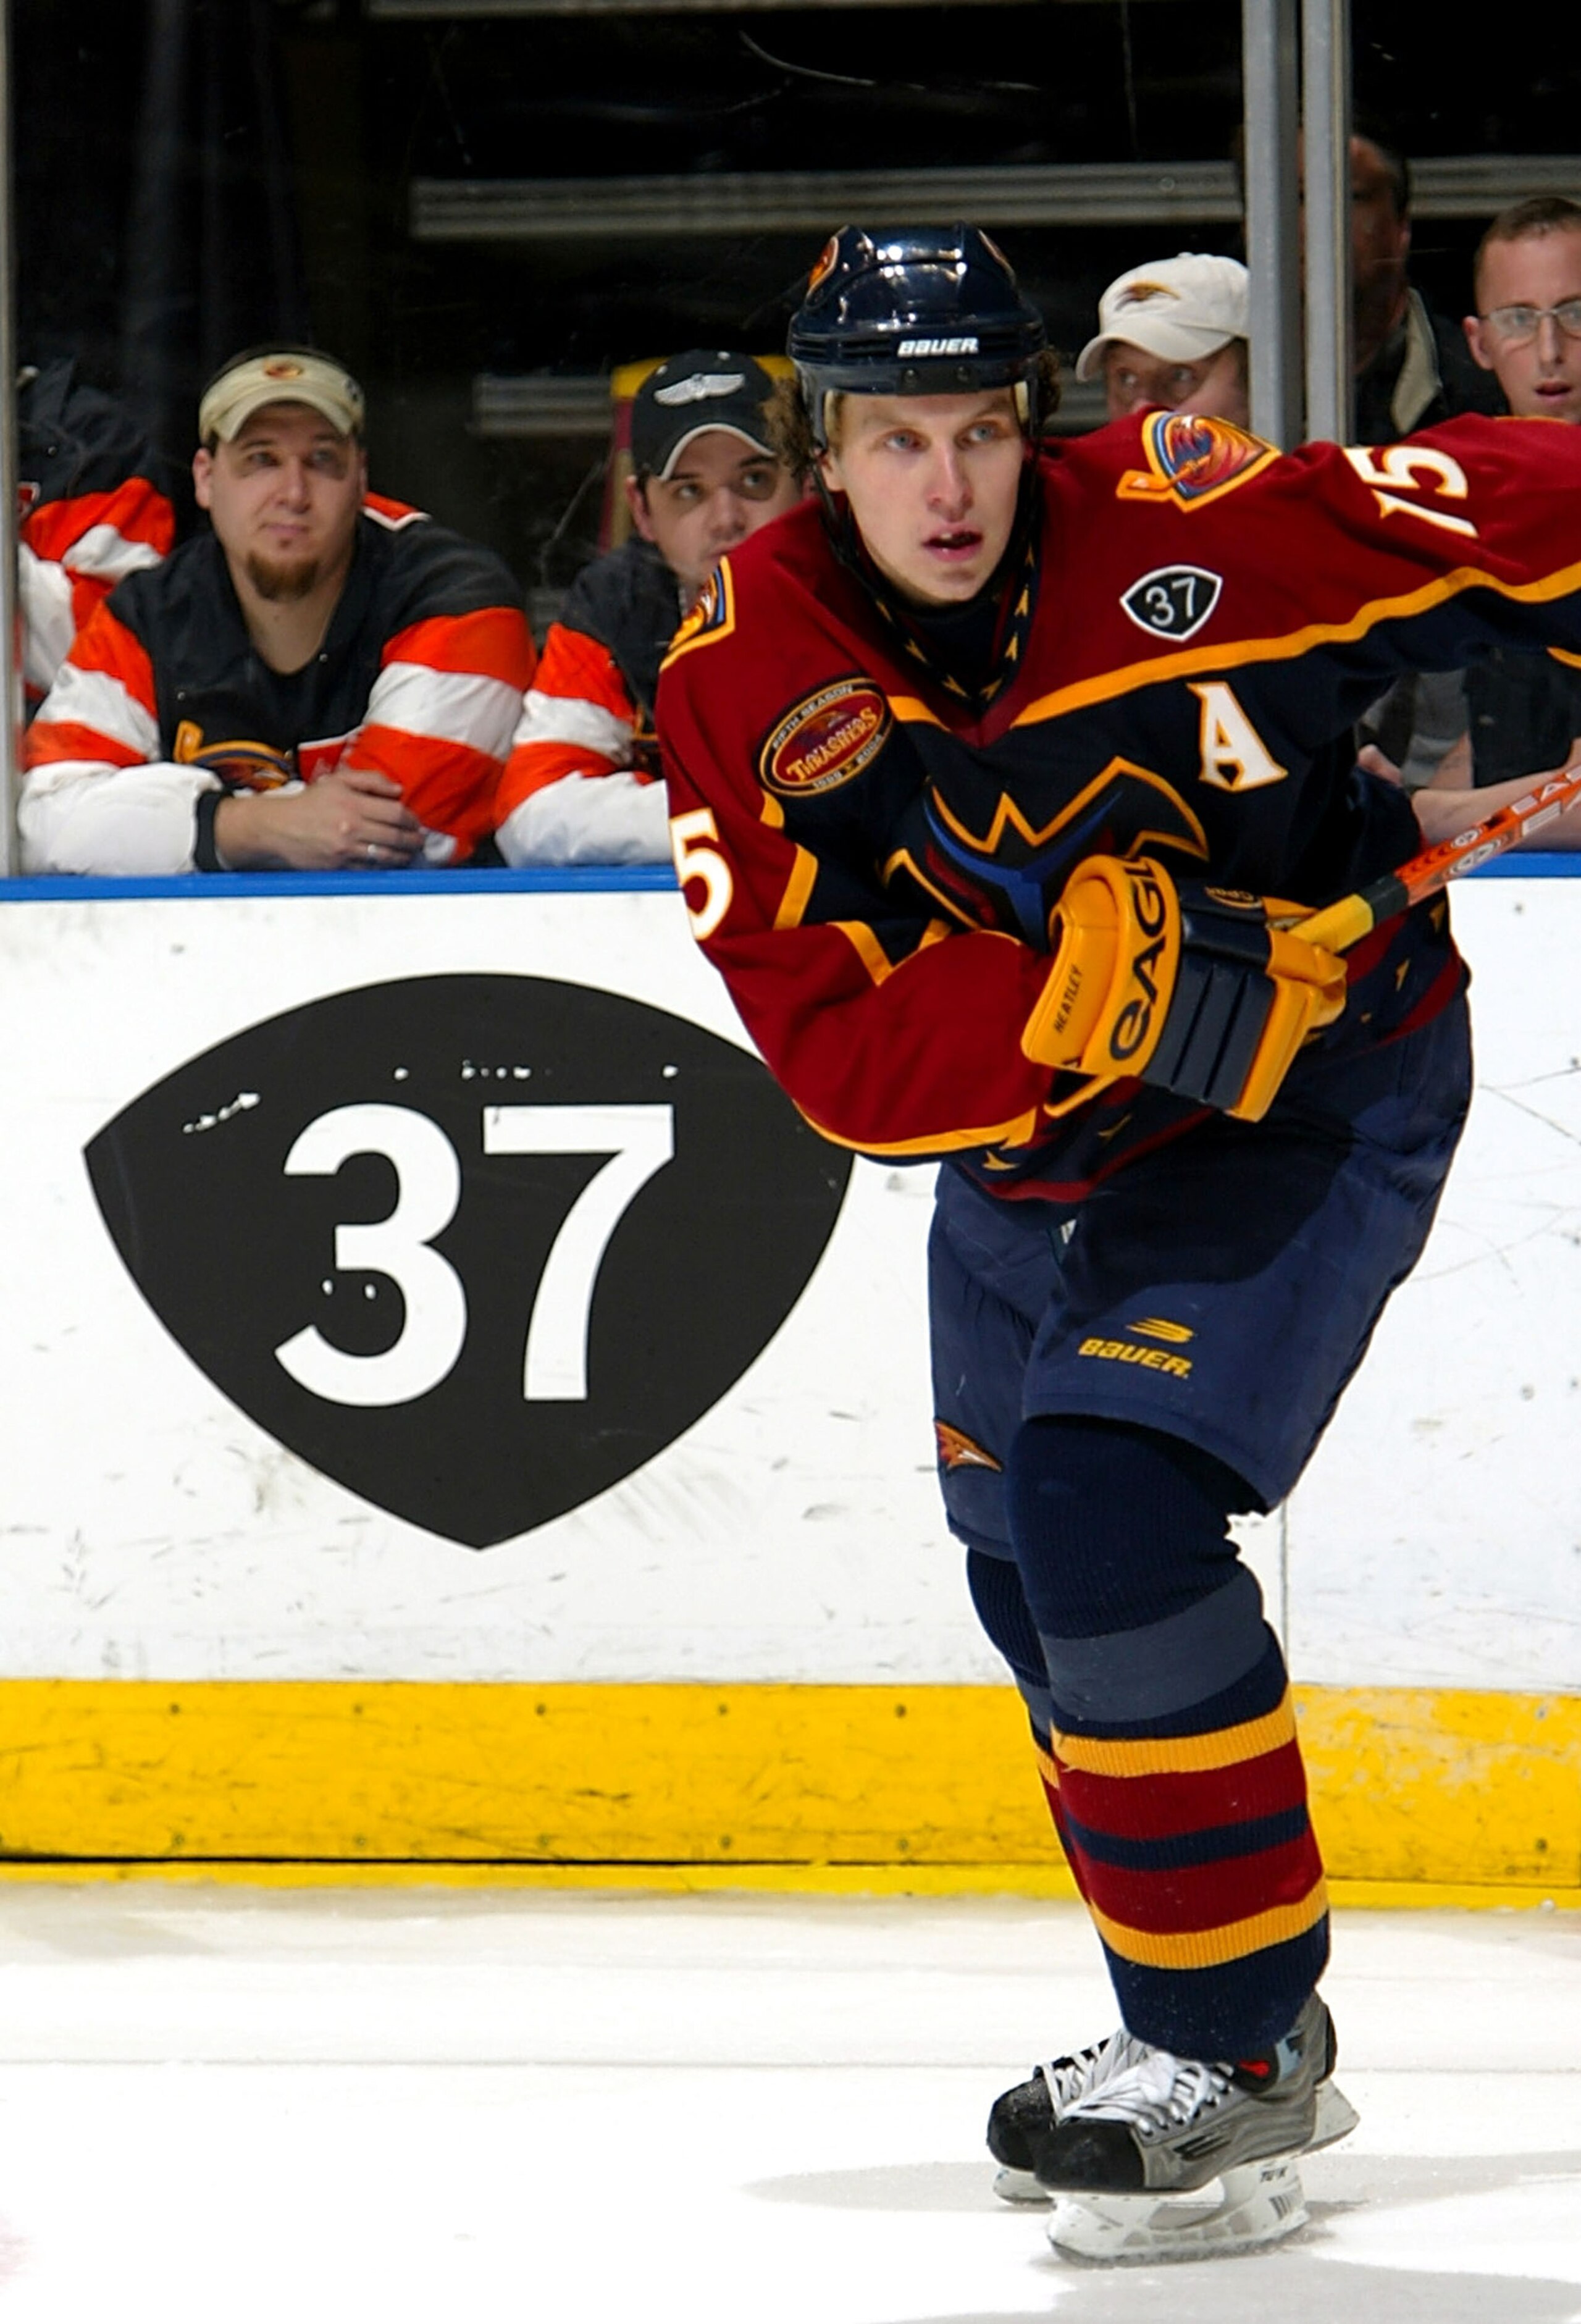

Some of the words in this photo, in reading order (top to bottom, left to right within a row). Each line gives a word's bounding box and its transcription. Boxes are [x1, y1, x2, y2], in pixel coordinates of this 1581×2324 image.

[897, 338, 979, 358] BAUER
[1341, 447, 1479, 539] 15
[1146, 577, 1196, 627] 37
[772, 716, 799, 750] FIFTH
[800, 684, 853, 717] SEASON
[1186, 681, 1288, 791] A
[669, 807, 733, 940] 5
[1054, 963, 1083, 1033] HEATLEY
[275, 1103, 674, 1407] 37
